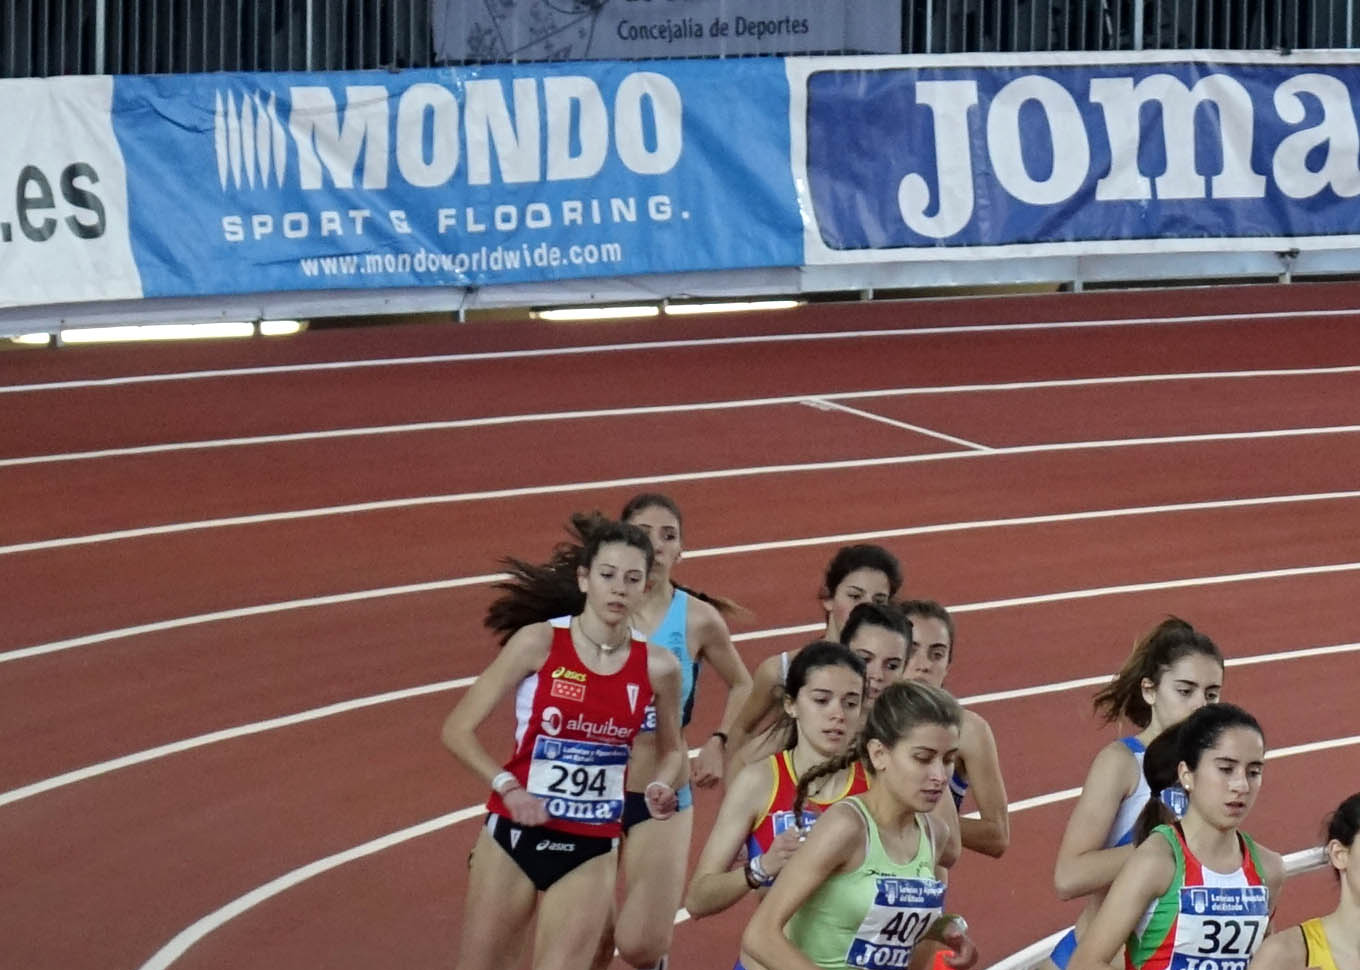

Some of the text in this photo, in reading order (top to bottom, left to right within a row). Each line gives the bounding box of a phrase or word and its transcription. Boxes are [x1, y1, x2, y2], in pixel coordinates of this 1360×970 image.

[708, 19, 729, 38] de
[735, 15, 809, 40] Deportes
[290, 71, 684, 191] MONDO
[221, 209, 371, 243] SPORT
[301, 240, 622, 277] www.mondoworldwide.com
[566, 713, 634, 738] alquiber
[547, 765, 607, 797] 294
[880, 911, 932, 944] 401
[1197, 920, 1260, 955] 327
[855, 943, 909, 967] Jom
